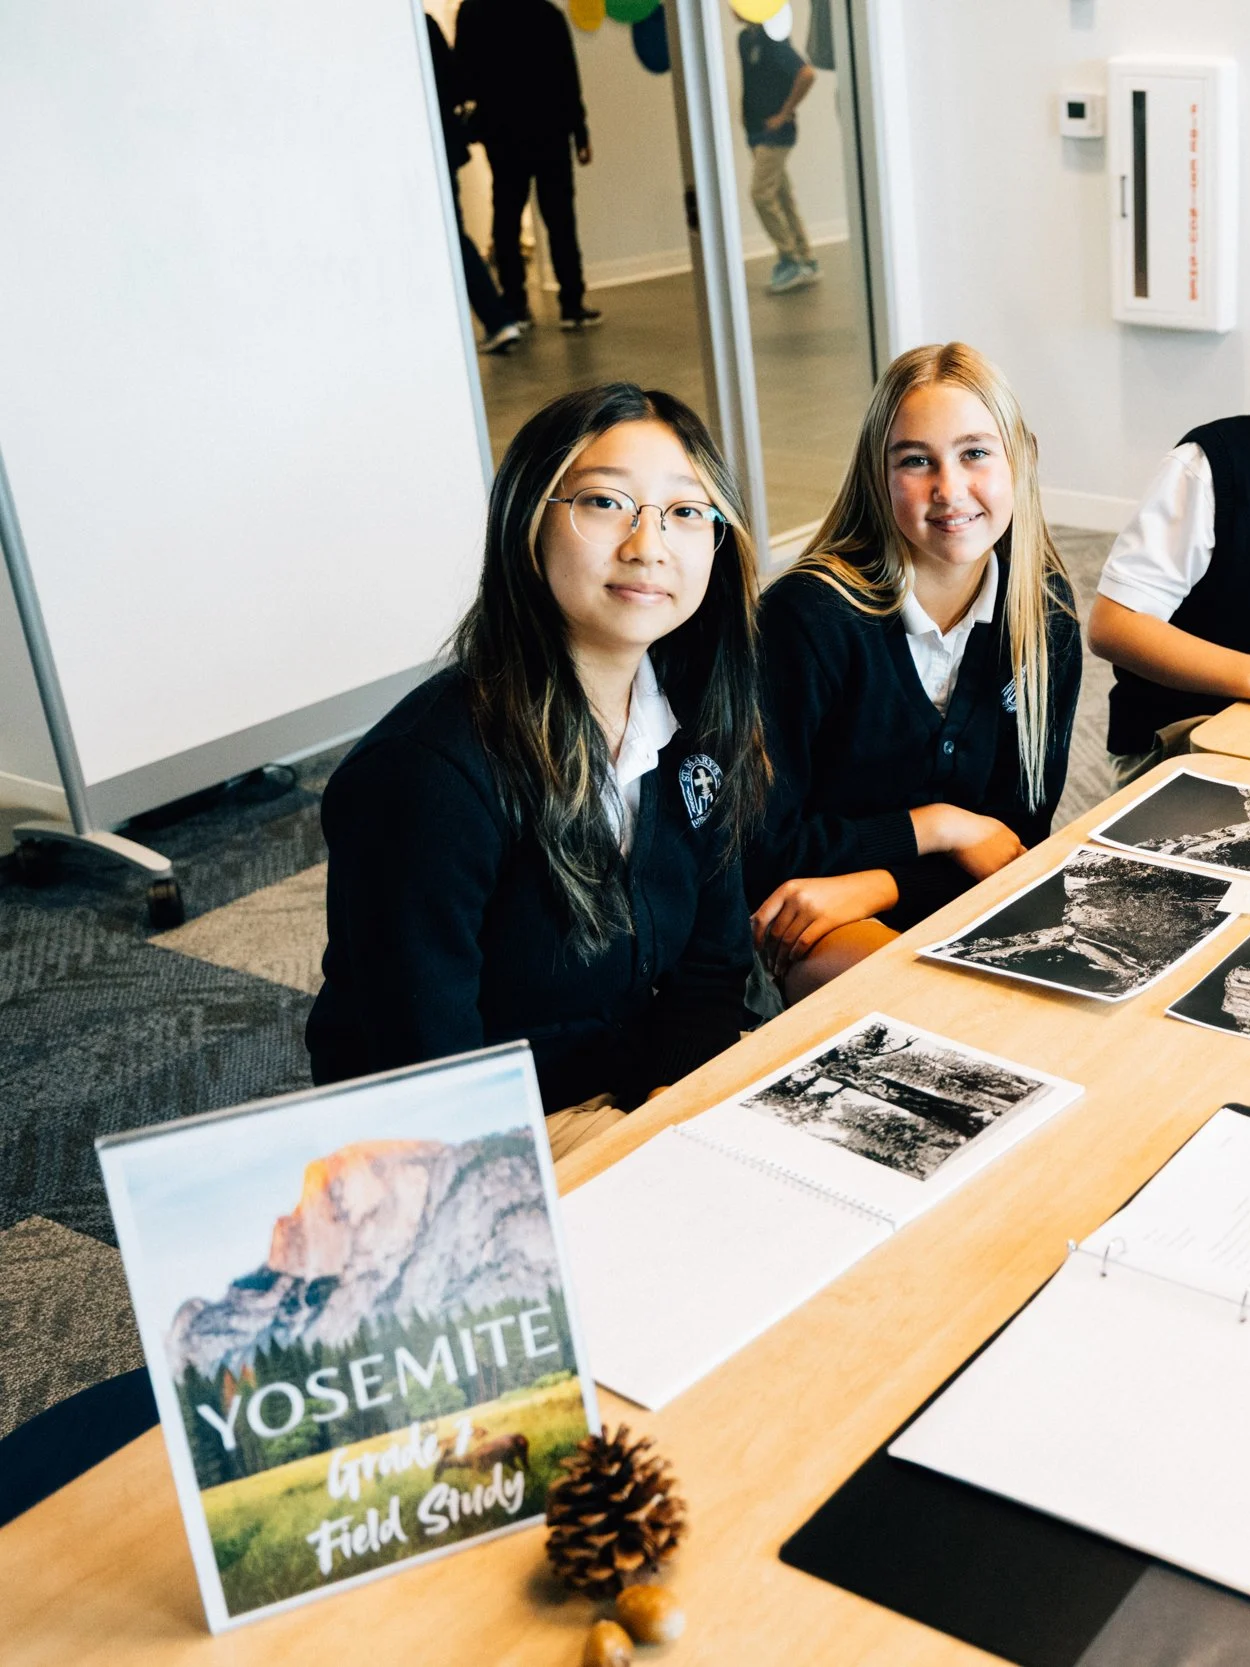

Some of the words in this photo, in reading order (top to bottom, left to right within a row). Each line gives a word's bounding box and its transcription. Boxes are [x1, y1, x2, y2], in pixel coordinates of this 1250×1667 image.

[196, 1306, 559, 1451] YOSEMITE
[327, 1422, 442, 1501] Grade
[306, 1496, 408, 1576] Field
[418, 1462, 526, 1536] Study
